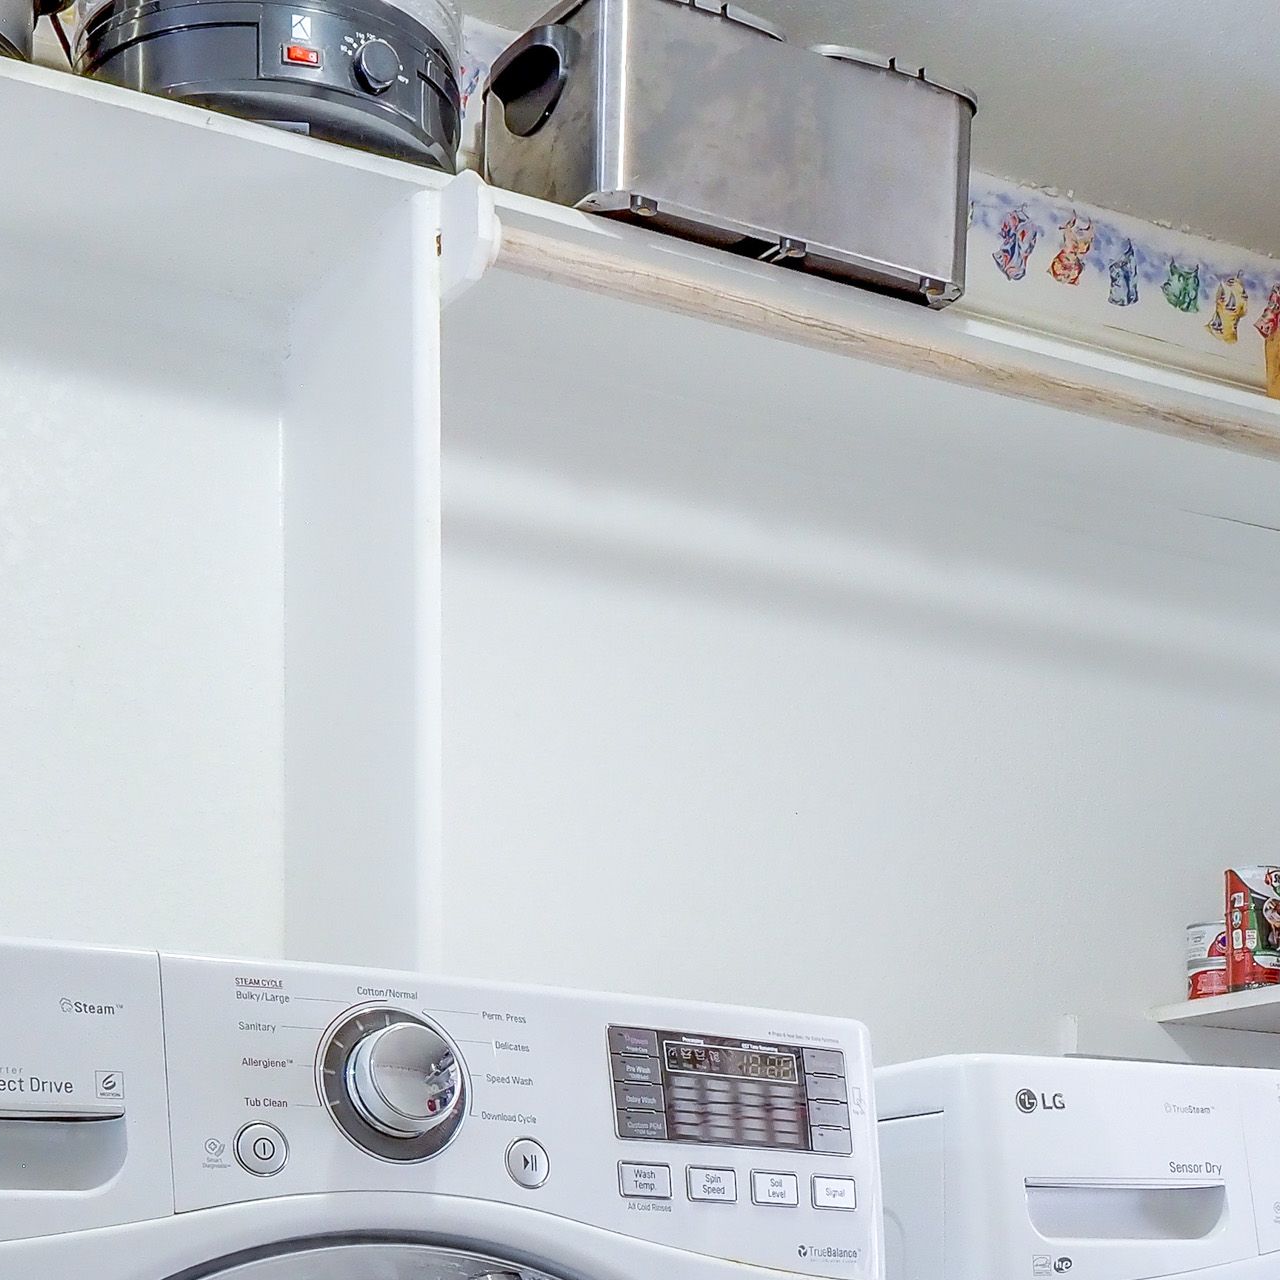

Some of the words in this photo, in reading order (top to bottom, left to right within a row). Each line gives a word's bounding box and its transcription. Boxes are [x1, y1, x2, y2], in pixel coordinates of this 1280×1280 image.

[235, 977, 260, 987] STEAM
[261, 979, 283, 988] CYCLE
[236, 991, 290, 1004] Bulky/Large
[357, 986, 418, 1000] Cotton/Normal
[505, 1013, 527, 1024] Press
[238, 1021, 277, 1033] Sanitary
[495, 1040, 530, 1053] Delicates
[30, 1077, 74, 1094] Drive
[486, 1074, 511, 1085] Speed
[511, 1076, 534, 1086] Wash
[244, 1097, 261, 1107] Tub
[264, 1098, 288, 1108] Clean
[1041, 1093, 1066, 1110] LG
[481, 1111, 517, 1123] Download
[517, 1113, 537, 1125] Cycle
[634, 1169, 656, 1179] Wash
[1168, 1161, 1203, 1174] Sensor
[1205, 1161, 1222, 1175] Dry
[634, 1180, 657, 1191] Temp.
[705, 1174, 722, 1185] Spin
[770, 1178, 783, 1188] Soil
[702, 1185, 726, 1196] Speed
[768, 1188, 786, 1199] Level
[825, 1187, 846, 1199] Signal
[637, 1202, 651, 1212] Cold
[808, 1246, 858, 1258] TrueBalance
